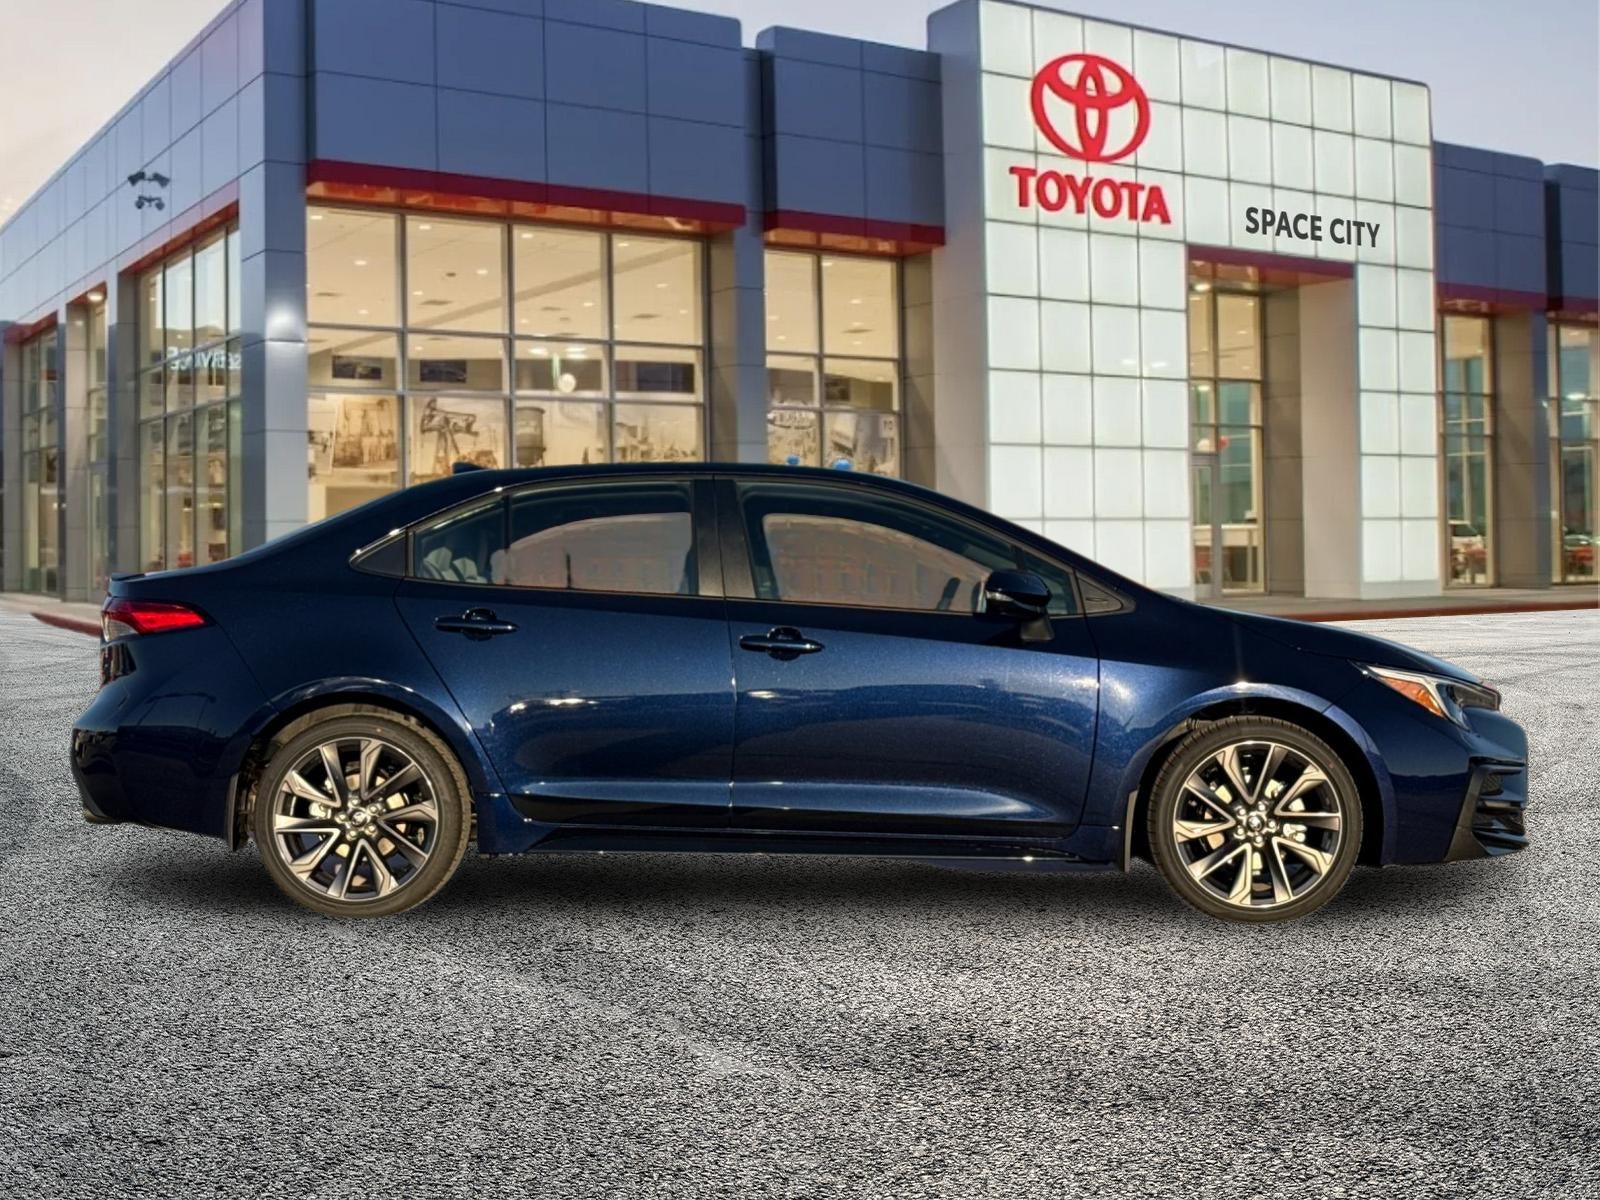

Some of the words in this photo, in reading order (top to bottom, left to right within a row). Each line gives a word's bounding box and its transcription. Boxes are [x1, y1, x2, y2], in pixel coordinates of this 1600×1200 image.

[1009, 166, 1171, 224] TOYOTA
[1245, 206, 1323, 242] SPACE
[1329, 218, 1380, 248] CITY
